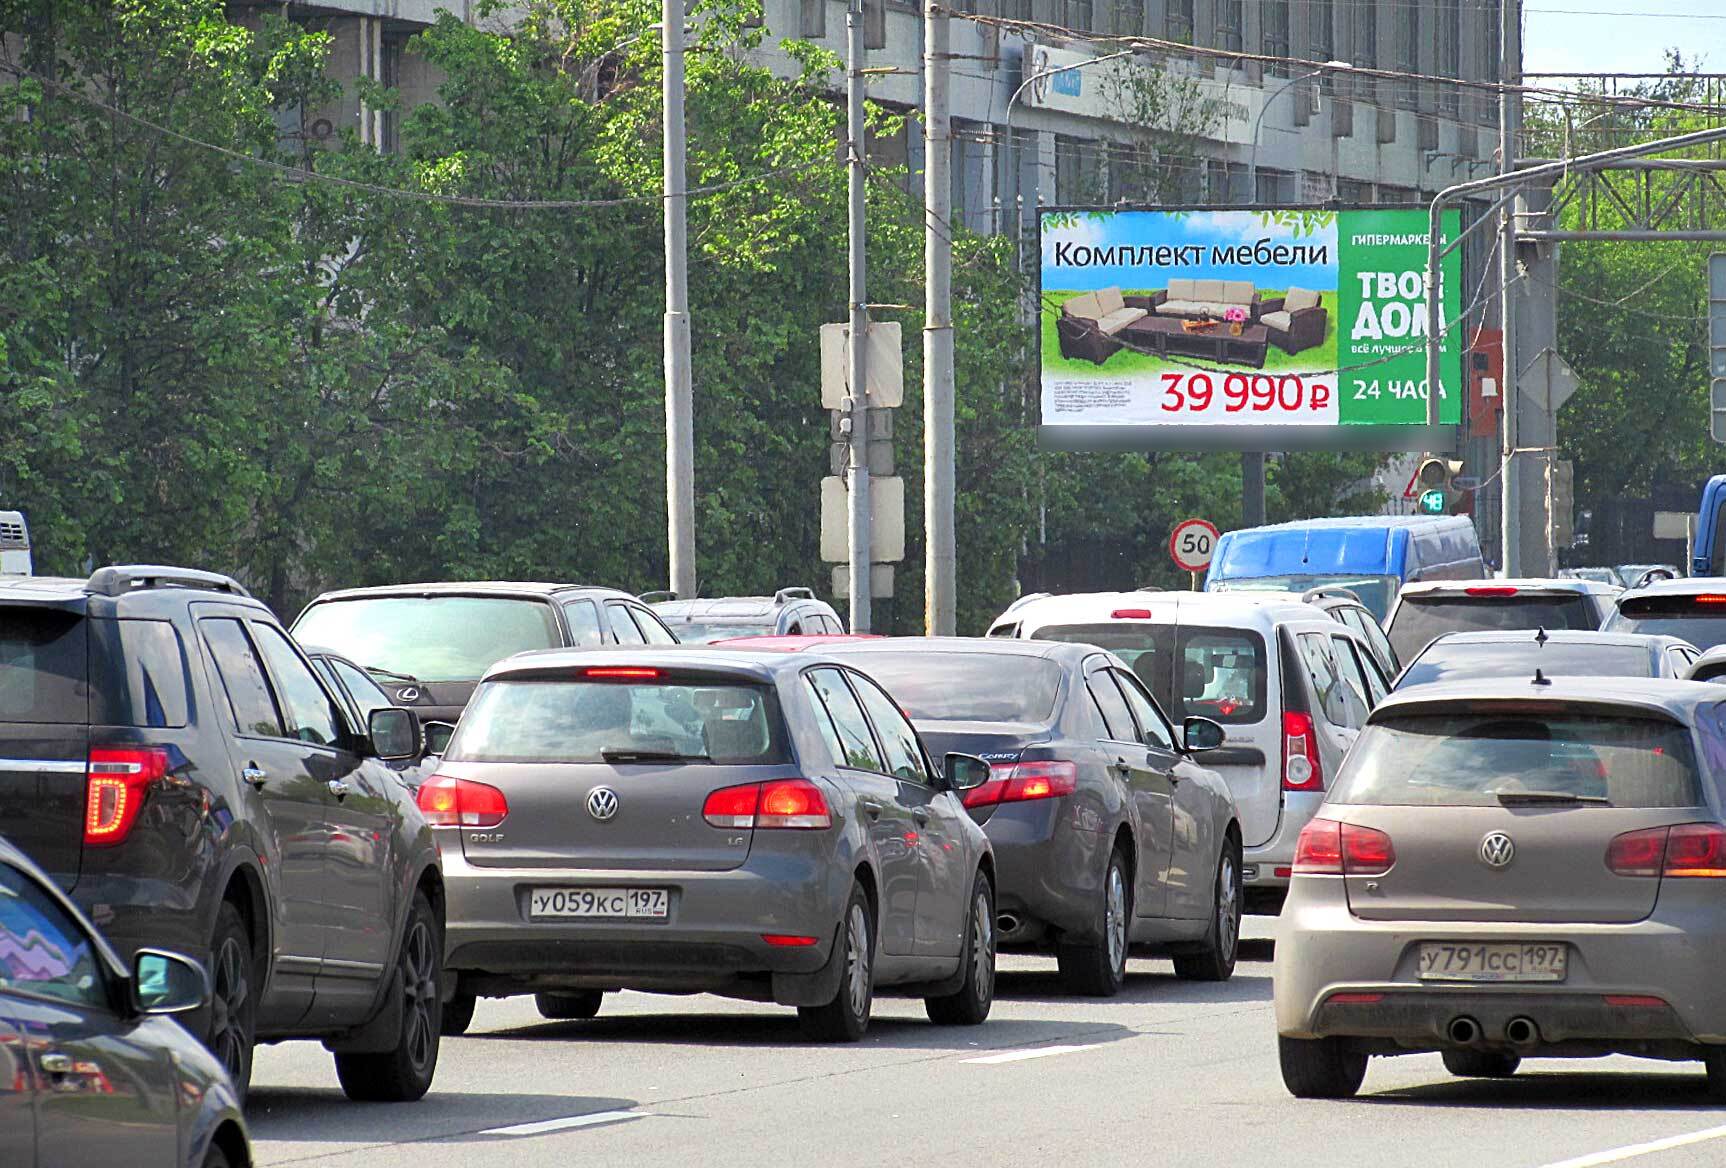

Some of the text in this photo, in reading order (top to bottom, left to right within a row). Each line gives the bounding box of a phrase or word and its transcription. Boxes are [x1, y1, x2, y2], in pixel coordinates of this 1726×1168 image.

[1352, 233, 1447, 246] ГИПЕРМАРКЕЫ
[1055, 238, 1328, 267] Комплект мебели
[1351, 301, 1447, 340] ДОМ
[1161, 373, 1213, 412] 39
[1353, 379, 1381, 400] 24
[1423, 493, 1443, 512] 48
[1182, 534, 1210, 554] 50
[470, 833, 504, 843] GOLF
[539, 891, 662, 913] У059КС 197
[1427, 946, 1559, 971] У791СС 197
